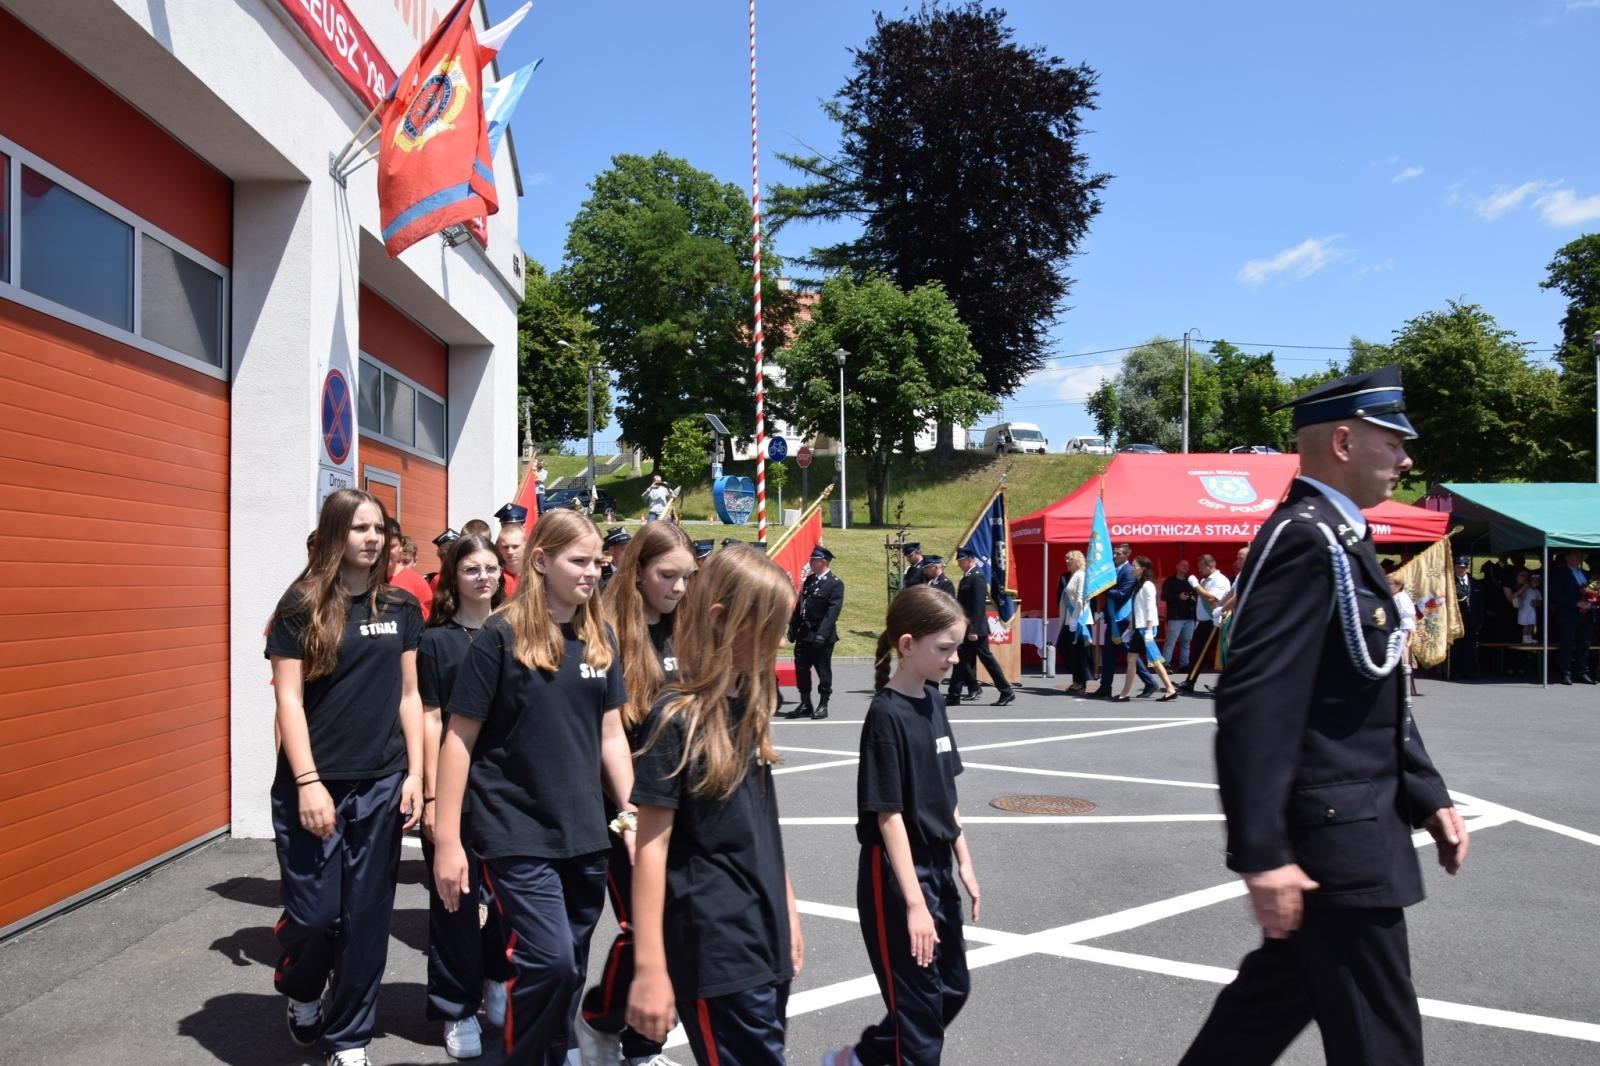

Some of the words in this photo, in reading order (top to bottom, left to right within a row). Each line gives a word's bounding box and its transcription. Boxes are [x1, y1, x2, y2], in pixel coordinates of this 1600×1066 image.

[302, 0, 359, 73] EUSZ
[798, 453, 810, 461] STOP
[1112, 524, 1201, 536] OCHOTNICZA
[1205, 522, 1250, 536] STRAŻ
